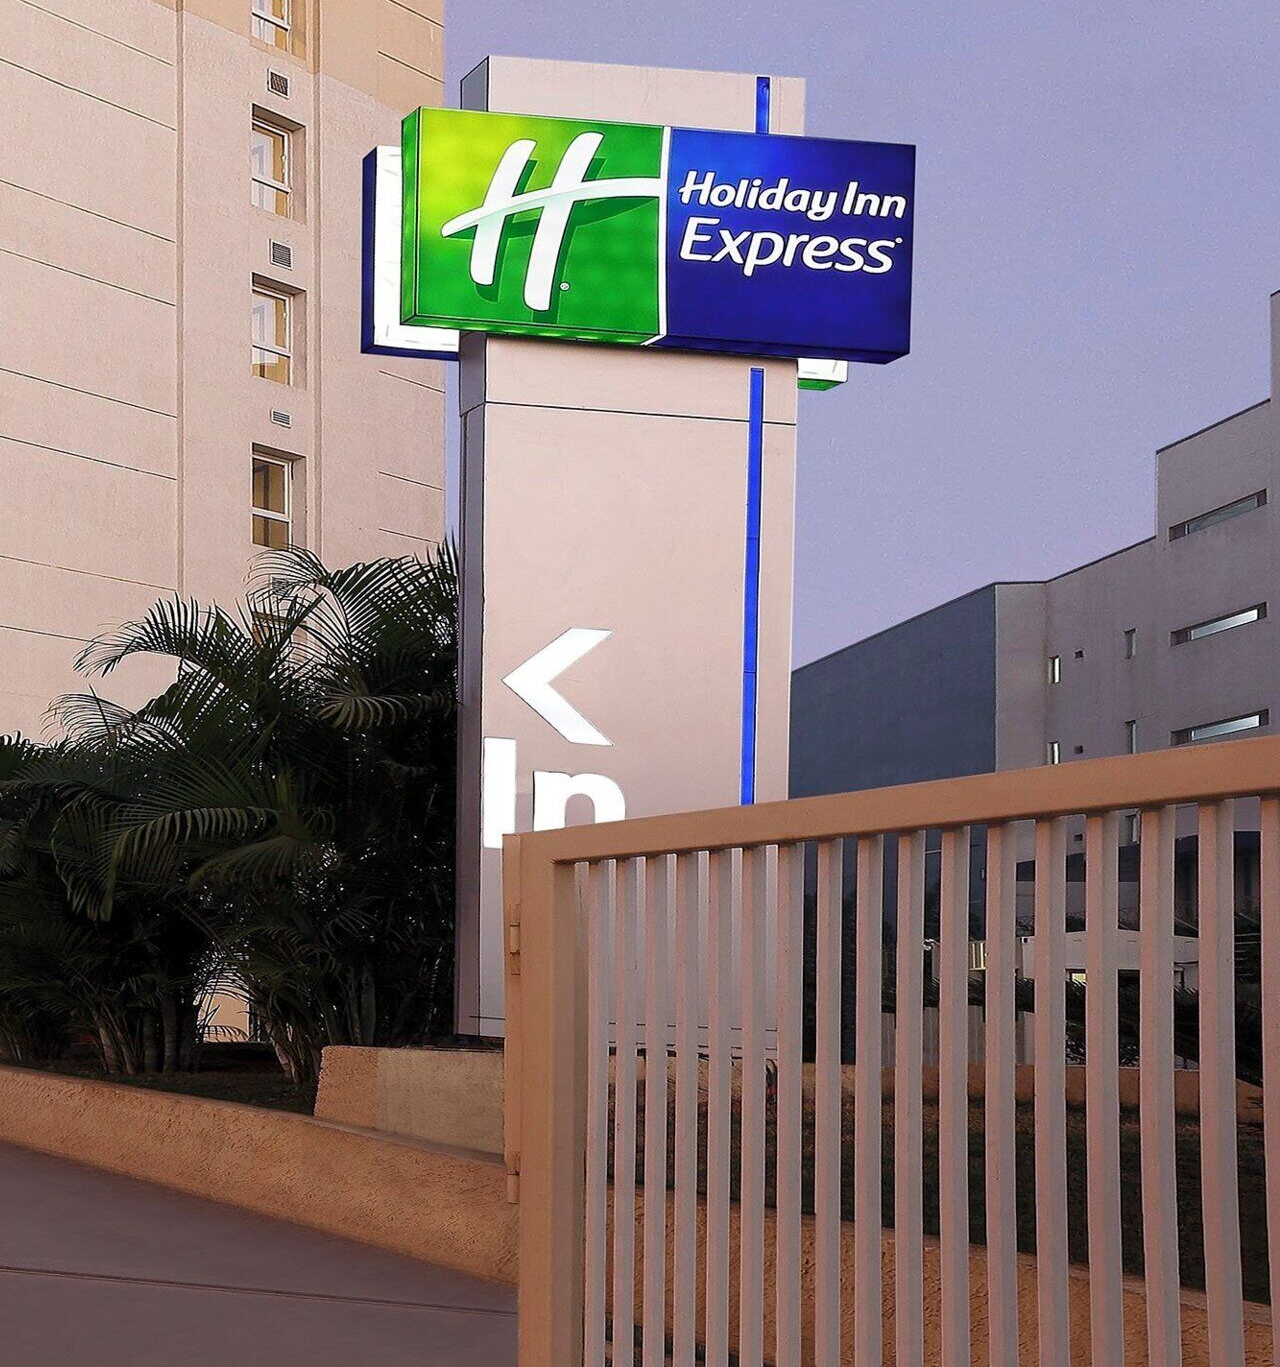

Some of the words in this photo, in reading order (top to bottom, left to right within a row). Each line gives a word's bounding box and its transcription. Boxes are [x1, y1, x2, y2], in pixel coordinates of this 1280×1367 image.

[677, 170, 839, 222] Holiday
[841, 180, 907, 219] Inn
[679, 216, 898, 277] Express
[483, 737, 625, 849] In
